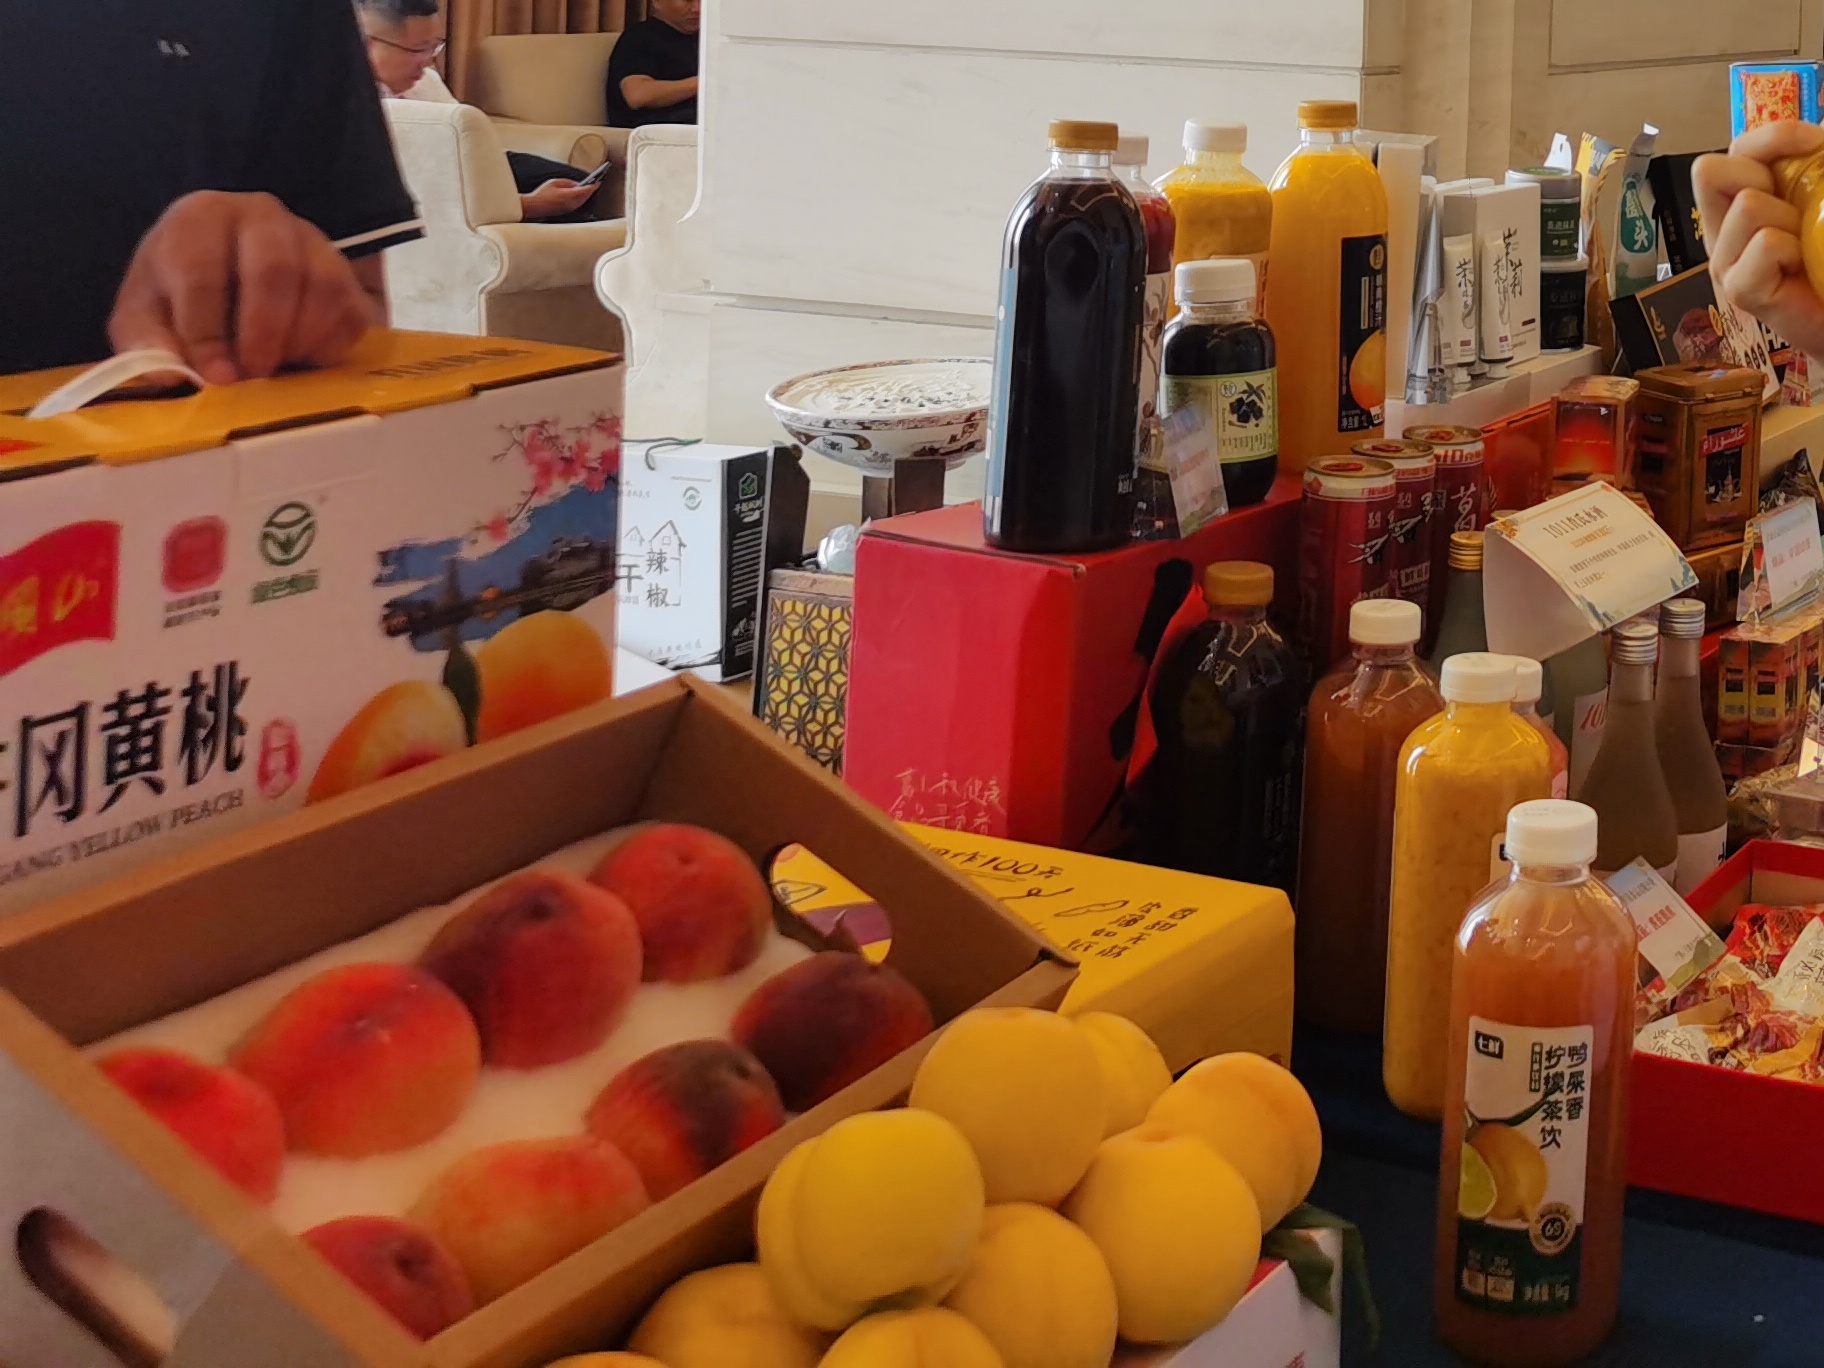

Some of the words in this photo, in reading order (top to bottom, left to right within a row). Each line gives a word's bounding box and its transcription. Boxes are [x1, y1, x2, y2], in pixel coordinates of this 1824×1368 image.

[646, 548, 670, 608] 辣椒
[0, 660, 250, 837] 冈黄桃
[169, 789, 244, 829] PEACH
[1539, 1045, 1566, 1150] 柠檬茶饮
